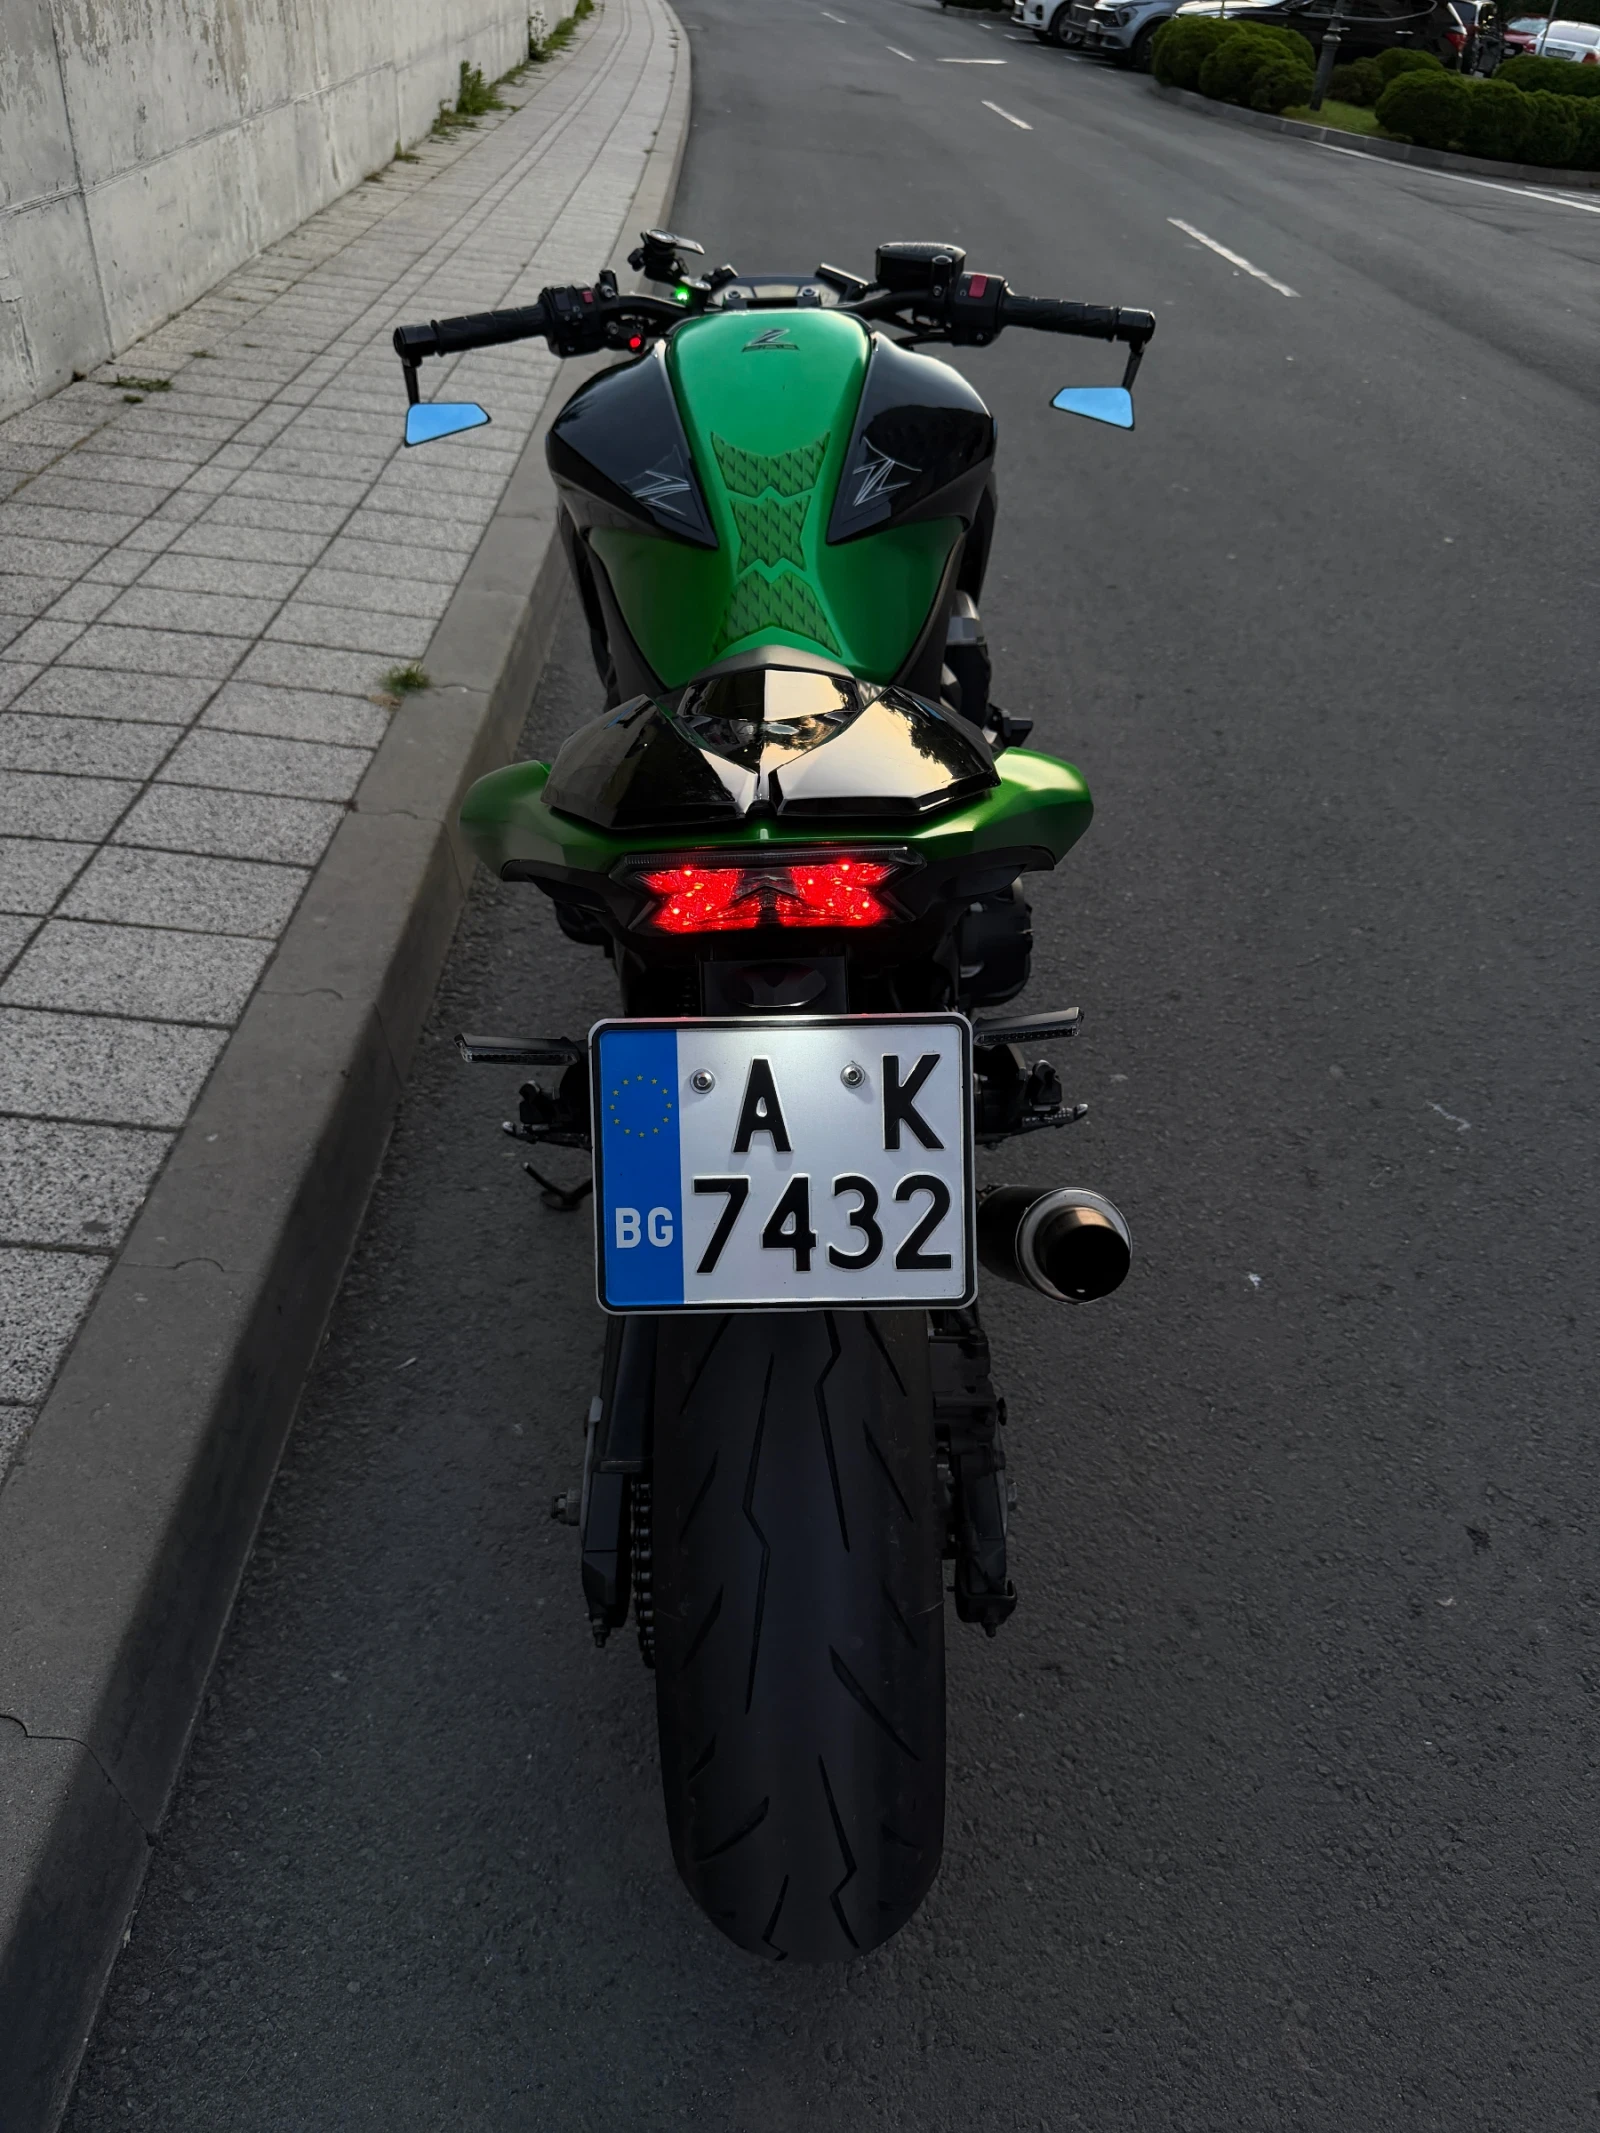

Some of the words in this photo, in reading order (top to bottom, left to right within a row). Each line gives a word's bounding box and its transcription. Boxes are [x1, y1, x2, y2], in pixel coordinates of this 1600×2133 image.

[732, 1056, 793, 1153] A
[882, 1053, 945, 1150] K
[615, 1207, 674, 1249] BG
[693, 1173, 953, 1274] 7432
